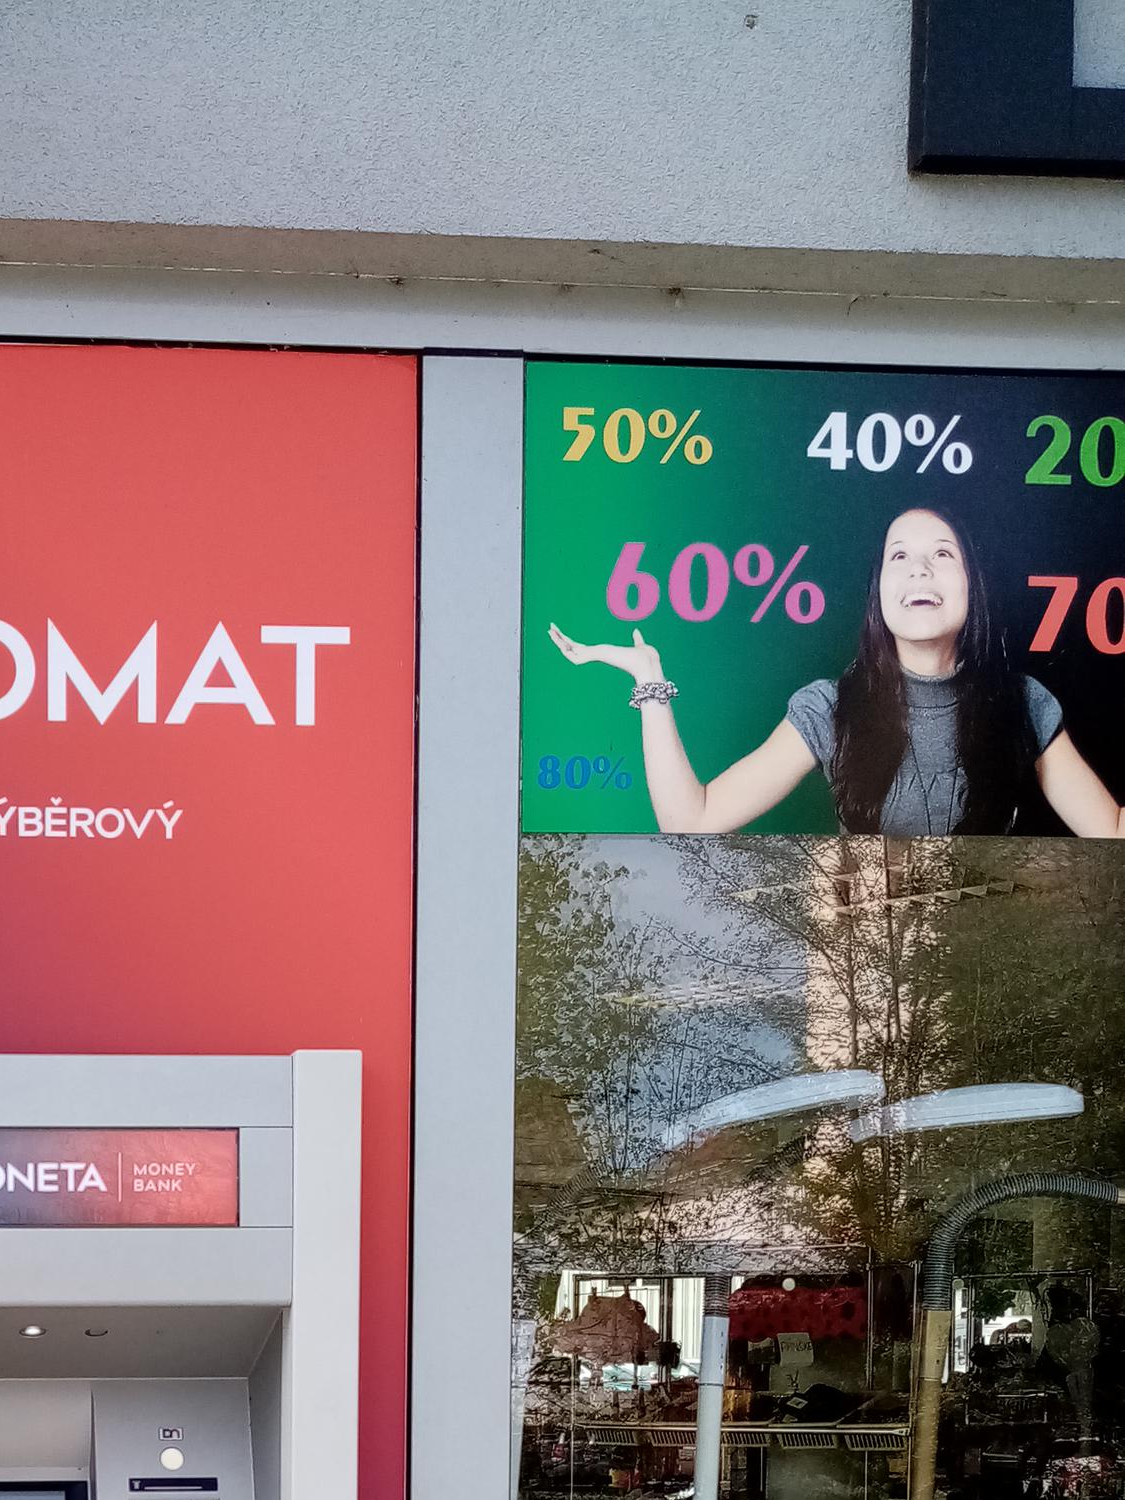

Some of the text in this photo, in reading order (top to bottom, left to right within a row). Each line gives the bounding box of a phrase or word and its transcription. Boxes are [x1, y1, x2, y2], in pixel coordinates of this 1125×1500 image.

[562, 407, 713, 466] 50%
[807, 411, 973, 475] 40%
[606, 541, 826, 625] 60%
[537, 754, 633, 791] 80%
[133, 1162, 197, 1177] MONEY
[133, 1178, 183, 1193] BANK
